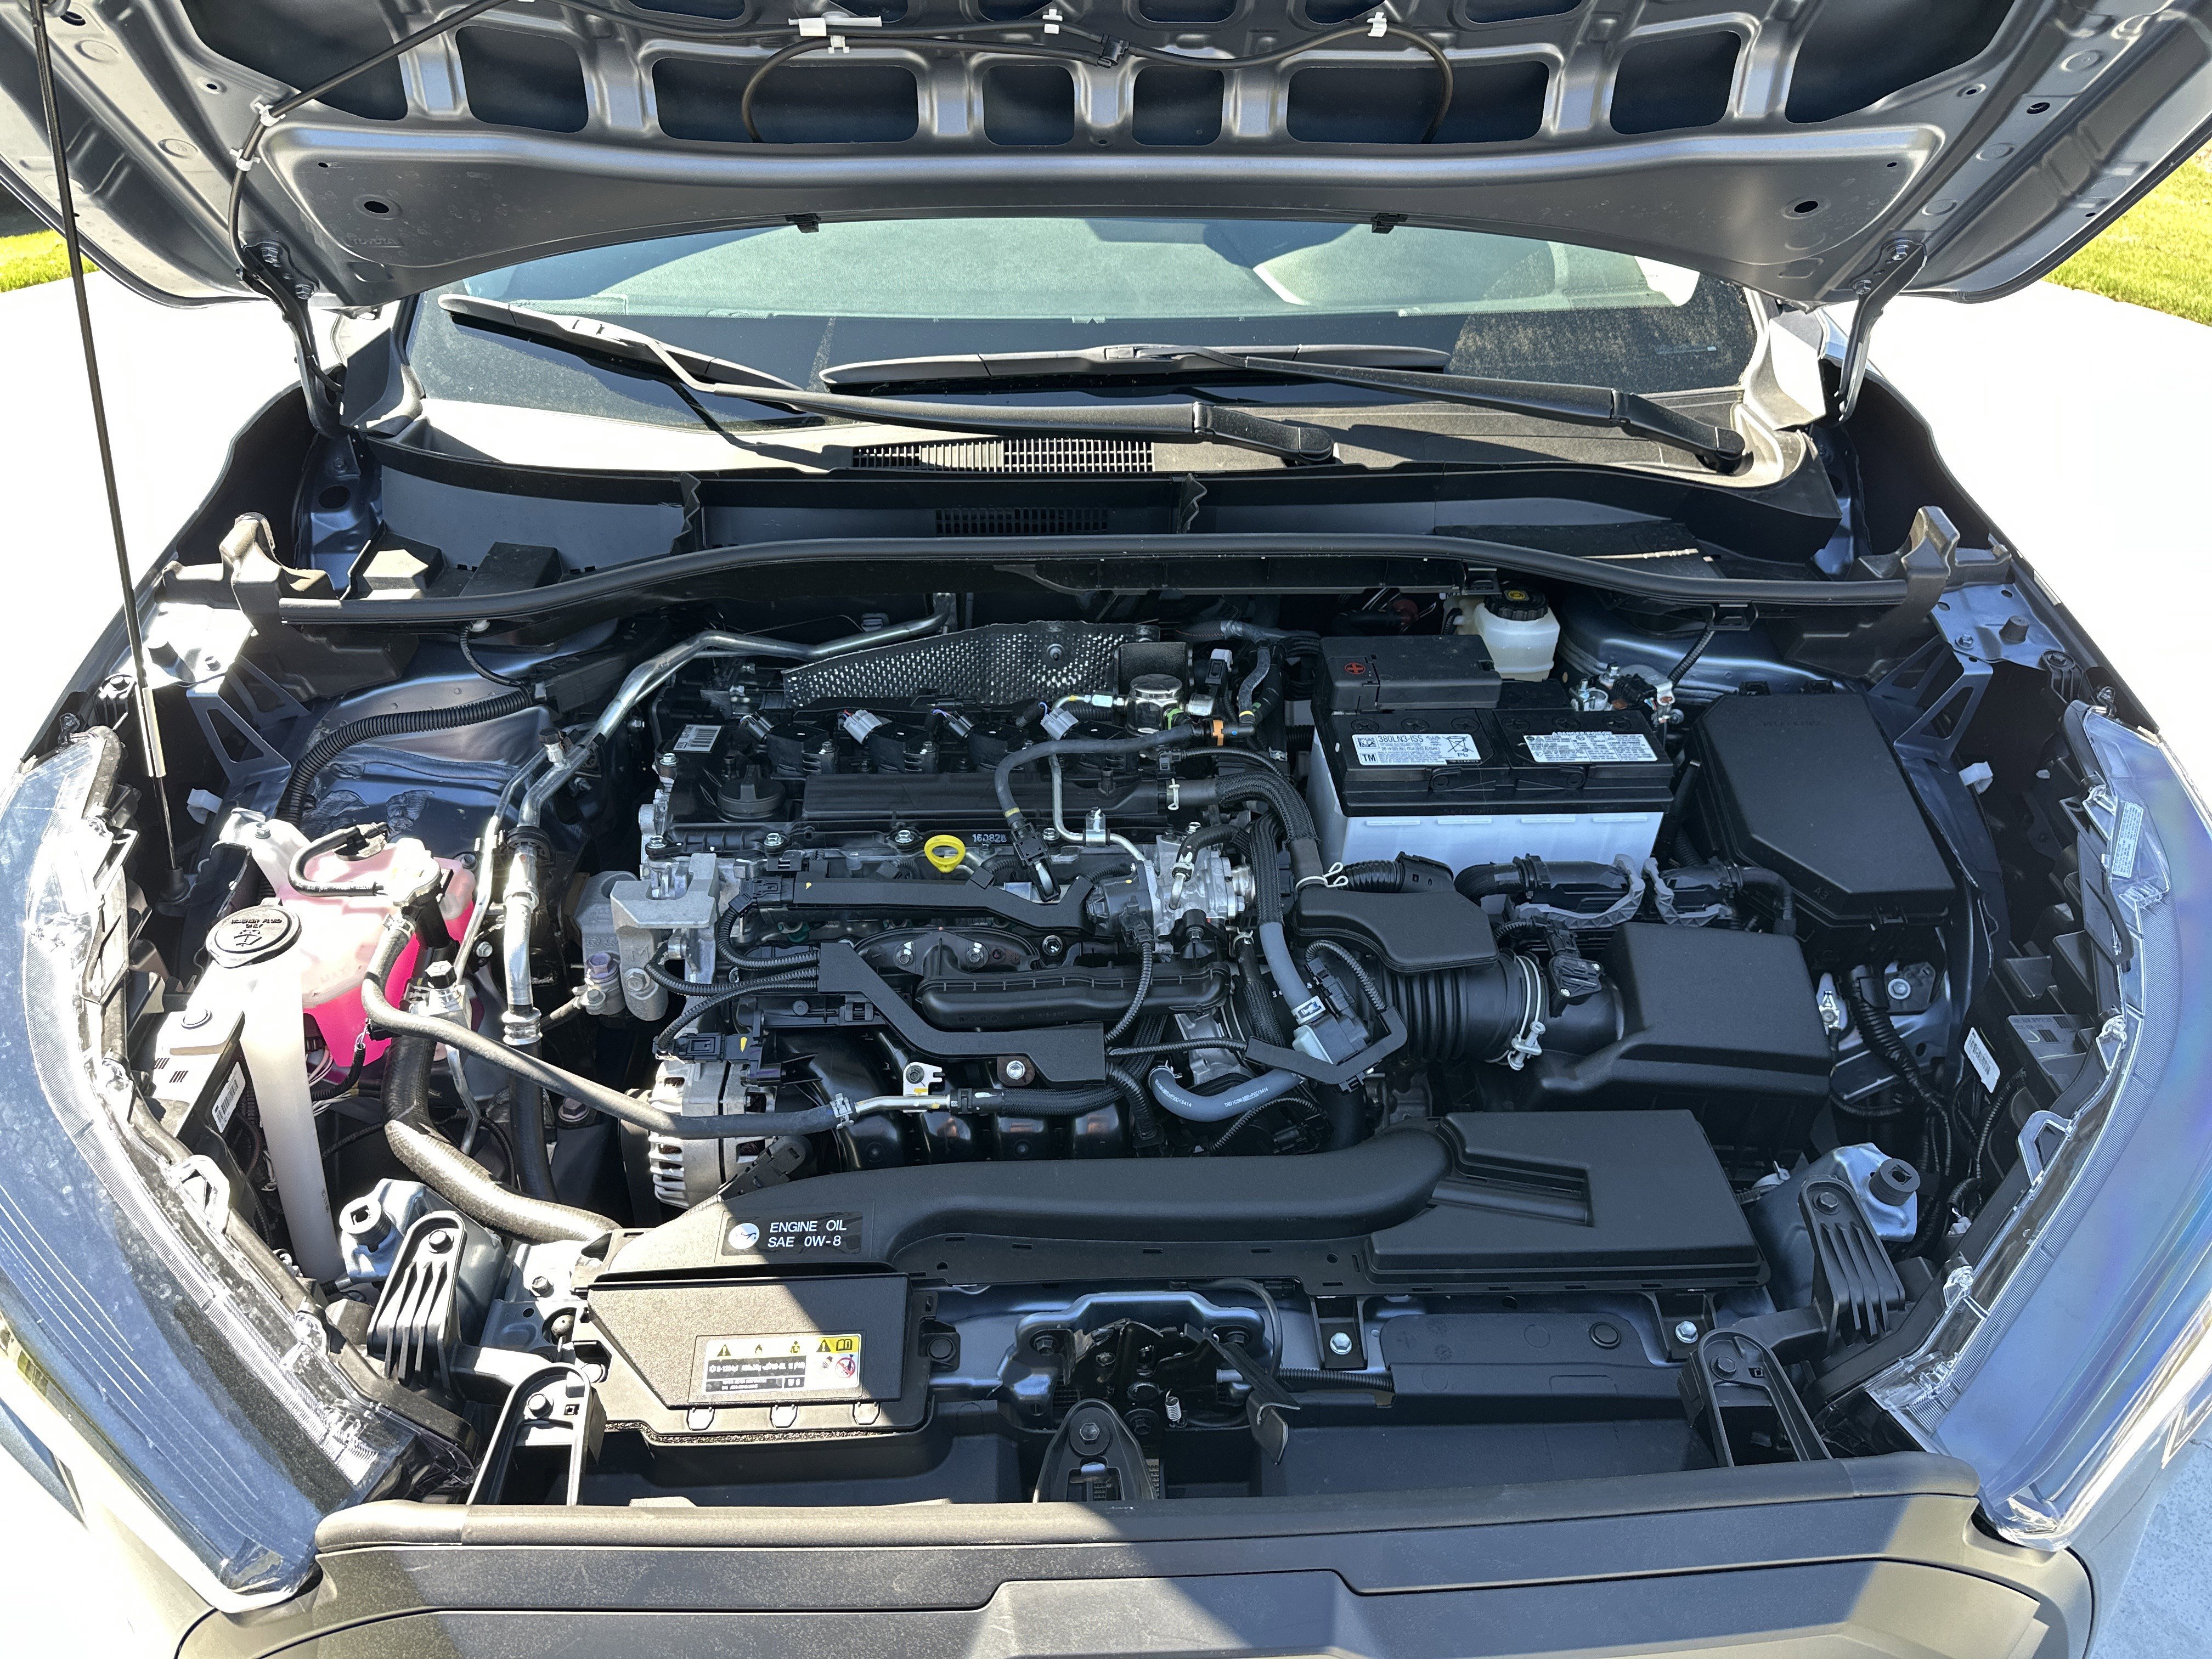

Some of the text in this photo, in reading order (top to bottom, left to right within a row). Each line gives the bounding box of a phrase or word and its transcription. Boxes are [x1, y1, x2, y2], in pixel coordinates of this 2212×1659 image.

[1378, 735, 1424, 743] 380LN3-ISS
[1362, 754, 1376, 762] TM
[770, 1220, 847, 1233] ENGINE OIL
[768, 1235, 842, 1248] SAE 0W-8
